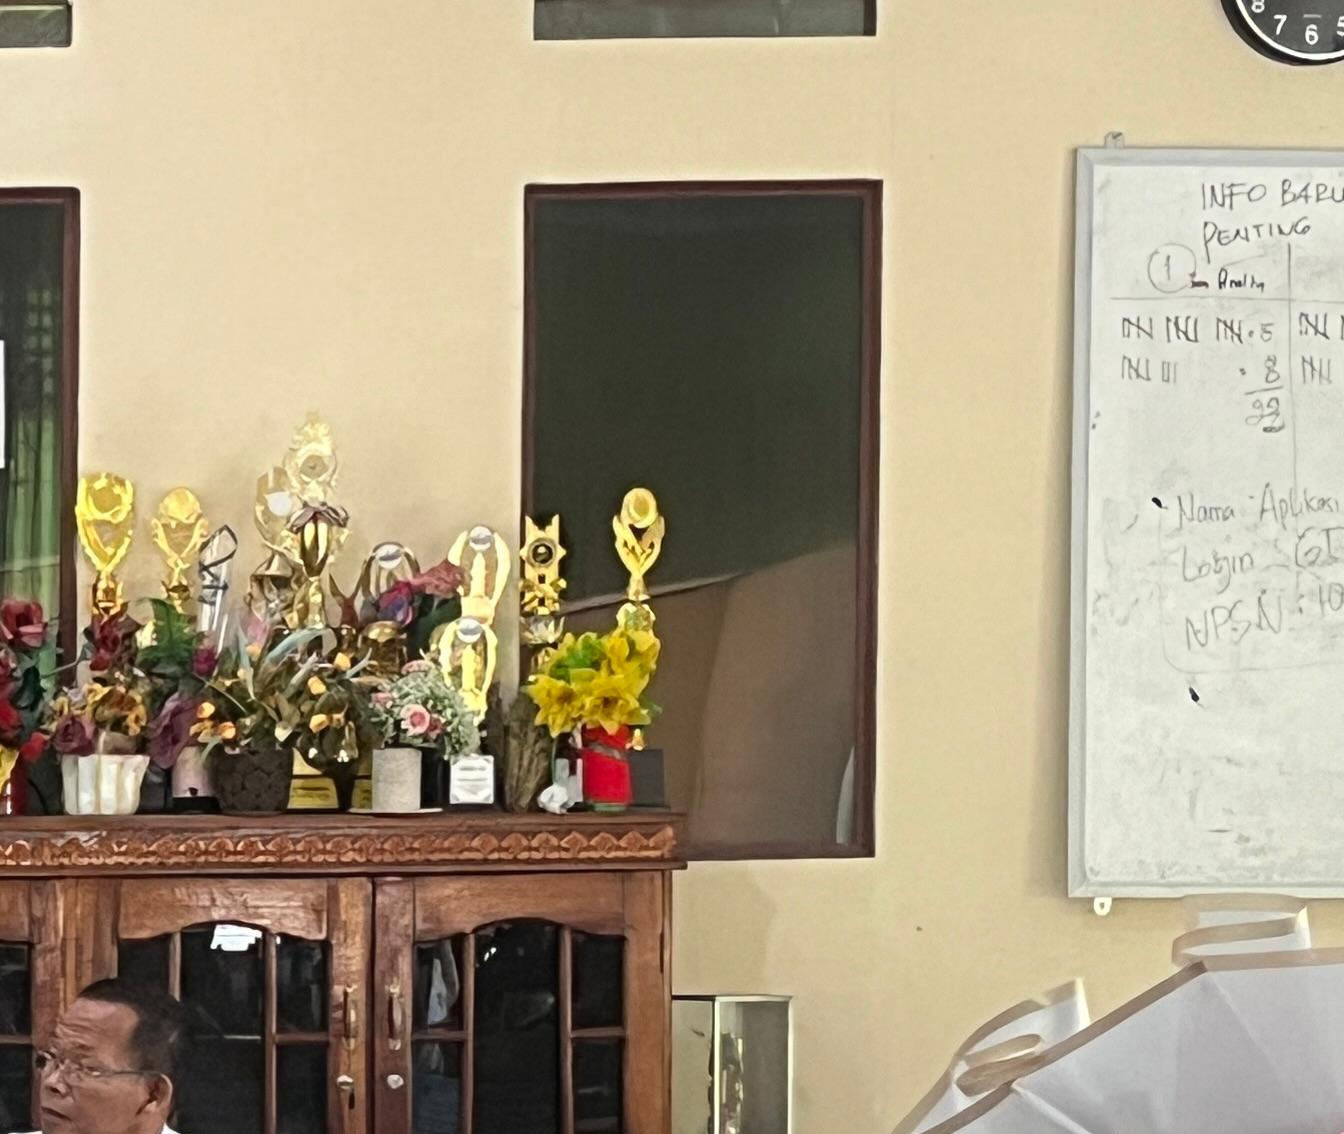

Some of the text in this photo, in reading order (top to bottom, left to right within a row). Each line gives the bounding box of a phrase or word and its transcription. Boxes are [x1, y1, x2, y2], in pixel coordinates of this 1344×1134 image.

[1273, 14, 1288, 36] 7
[1304, 24, 1319, 45] 6
[1201, 178, 1344, 211] INFO BARU
[1202, 216, 1312, 265] PENTING
[1264, 354, 1281, 384] 8
[1177, 491, 1236, 531] Nama
[1182, 545, 1255, 596] Login
